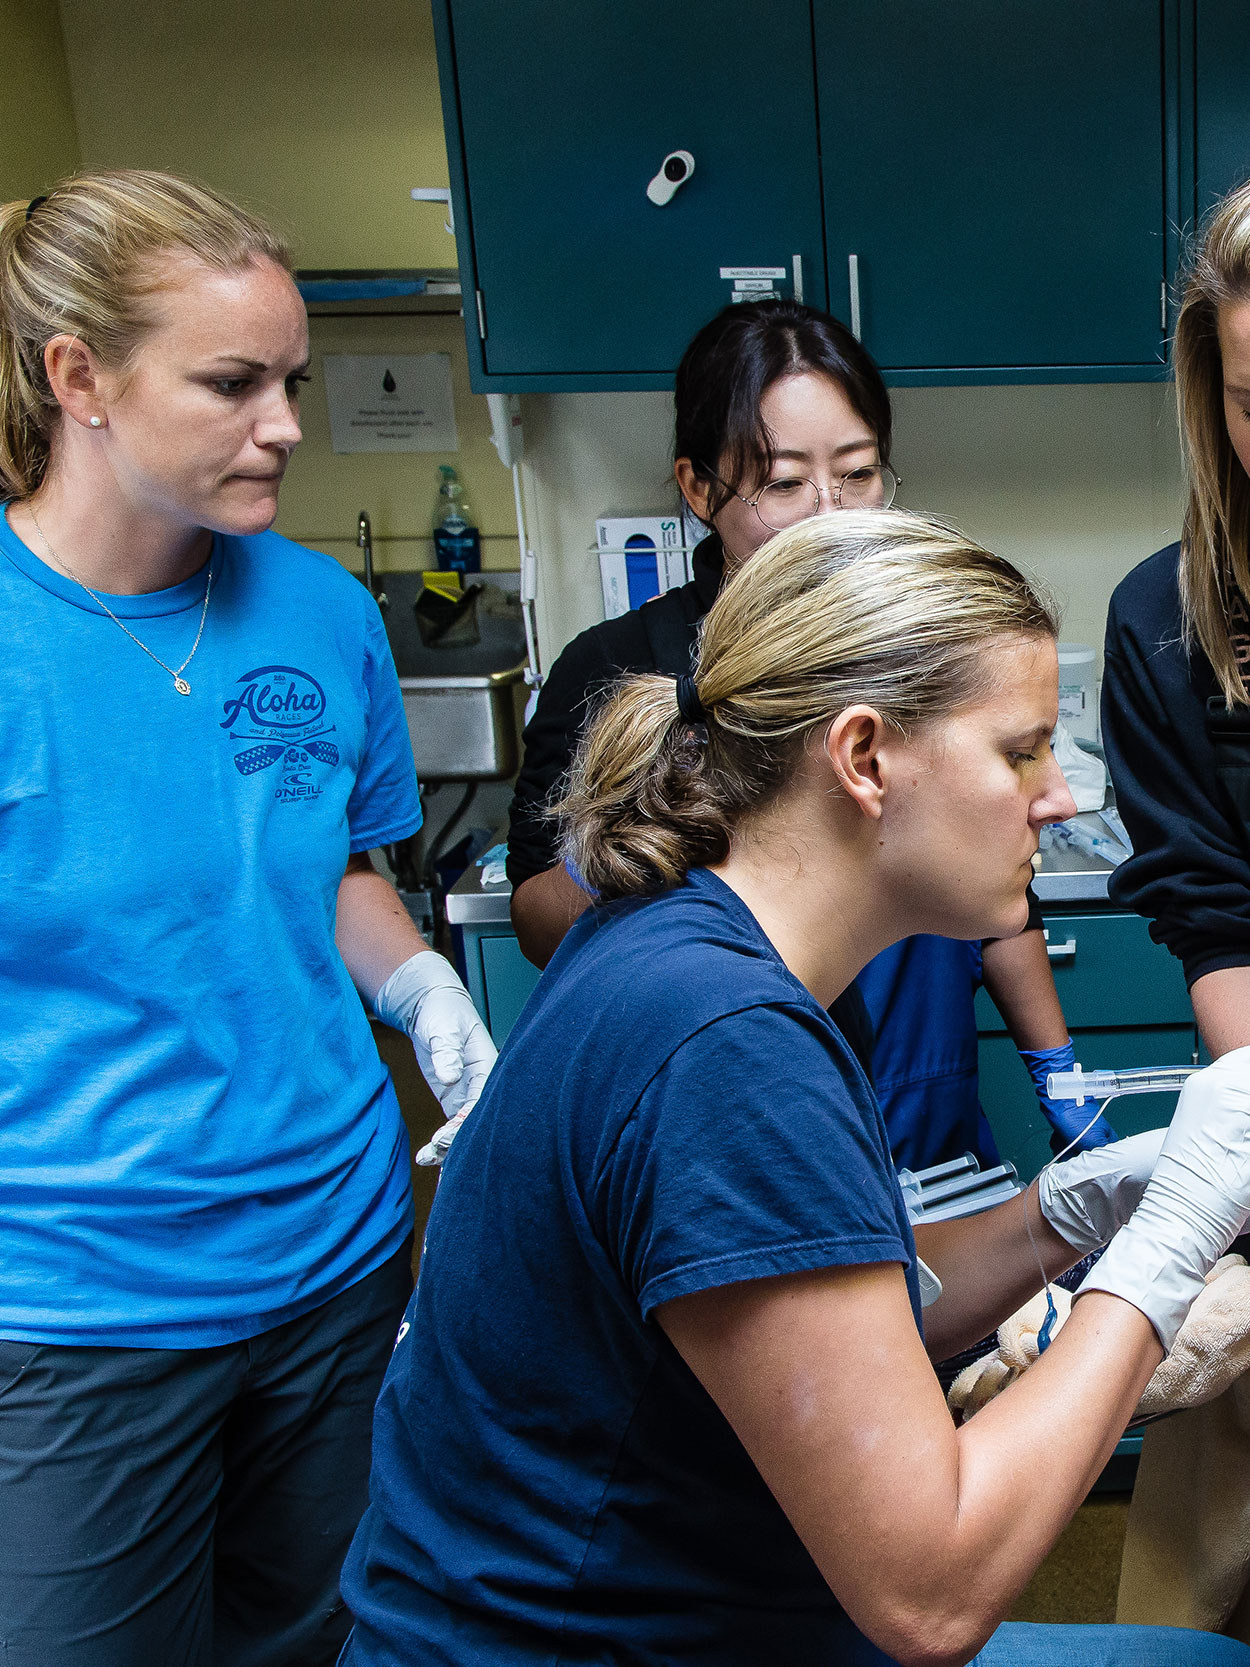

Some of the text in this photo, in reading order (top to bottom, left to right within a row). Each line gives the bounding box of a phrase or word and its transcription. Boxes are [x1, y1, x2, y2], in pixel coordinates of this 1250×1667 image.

[661, 521, 676, 531] S
[219, 680, 321, 729] Aloha
[276, 713, 301, 721] RACES
[274, 785, 324, 798] O'NEILL
